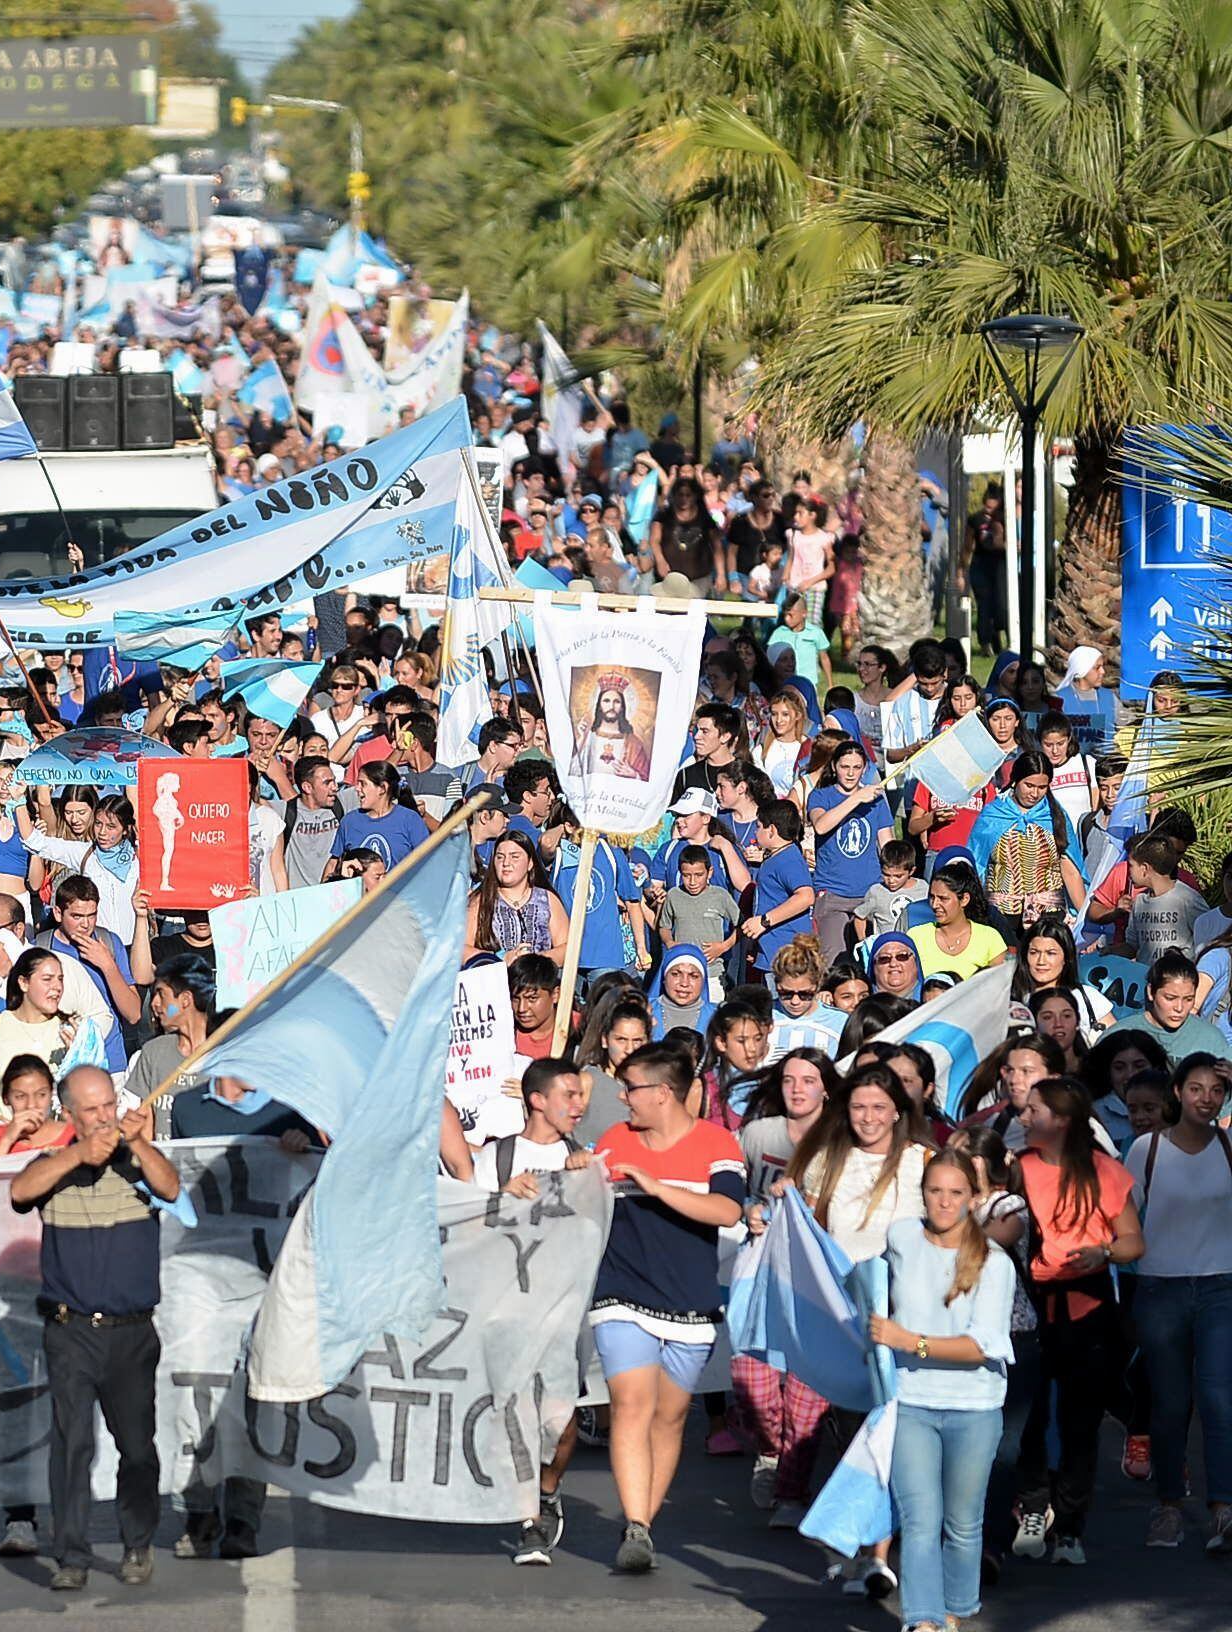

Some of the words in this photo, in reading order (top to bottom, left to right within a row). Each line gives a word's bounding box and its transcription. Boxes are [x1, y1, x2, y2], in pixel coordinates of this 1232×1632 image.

[23, 47, 118, 70] ABEJA
[190, 513, 248, 544] DEL
[255, 457, 379, 521] NIÑO
[188, 802, 230, 820] QUIERO
[190, 830, 227, 845] NACER
[478, 1003, 497, 1024] LA
[448, 1023, 494, 1046] UEREMOS
[449, 1043, 473, 1058] IVA
[360, 1306, 469, 1381] AZ
